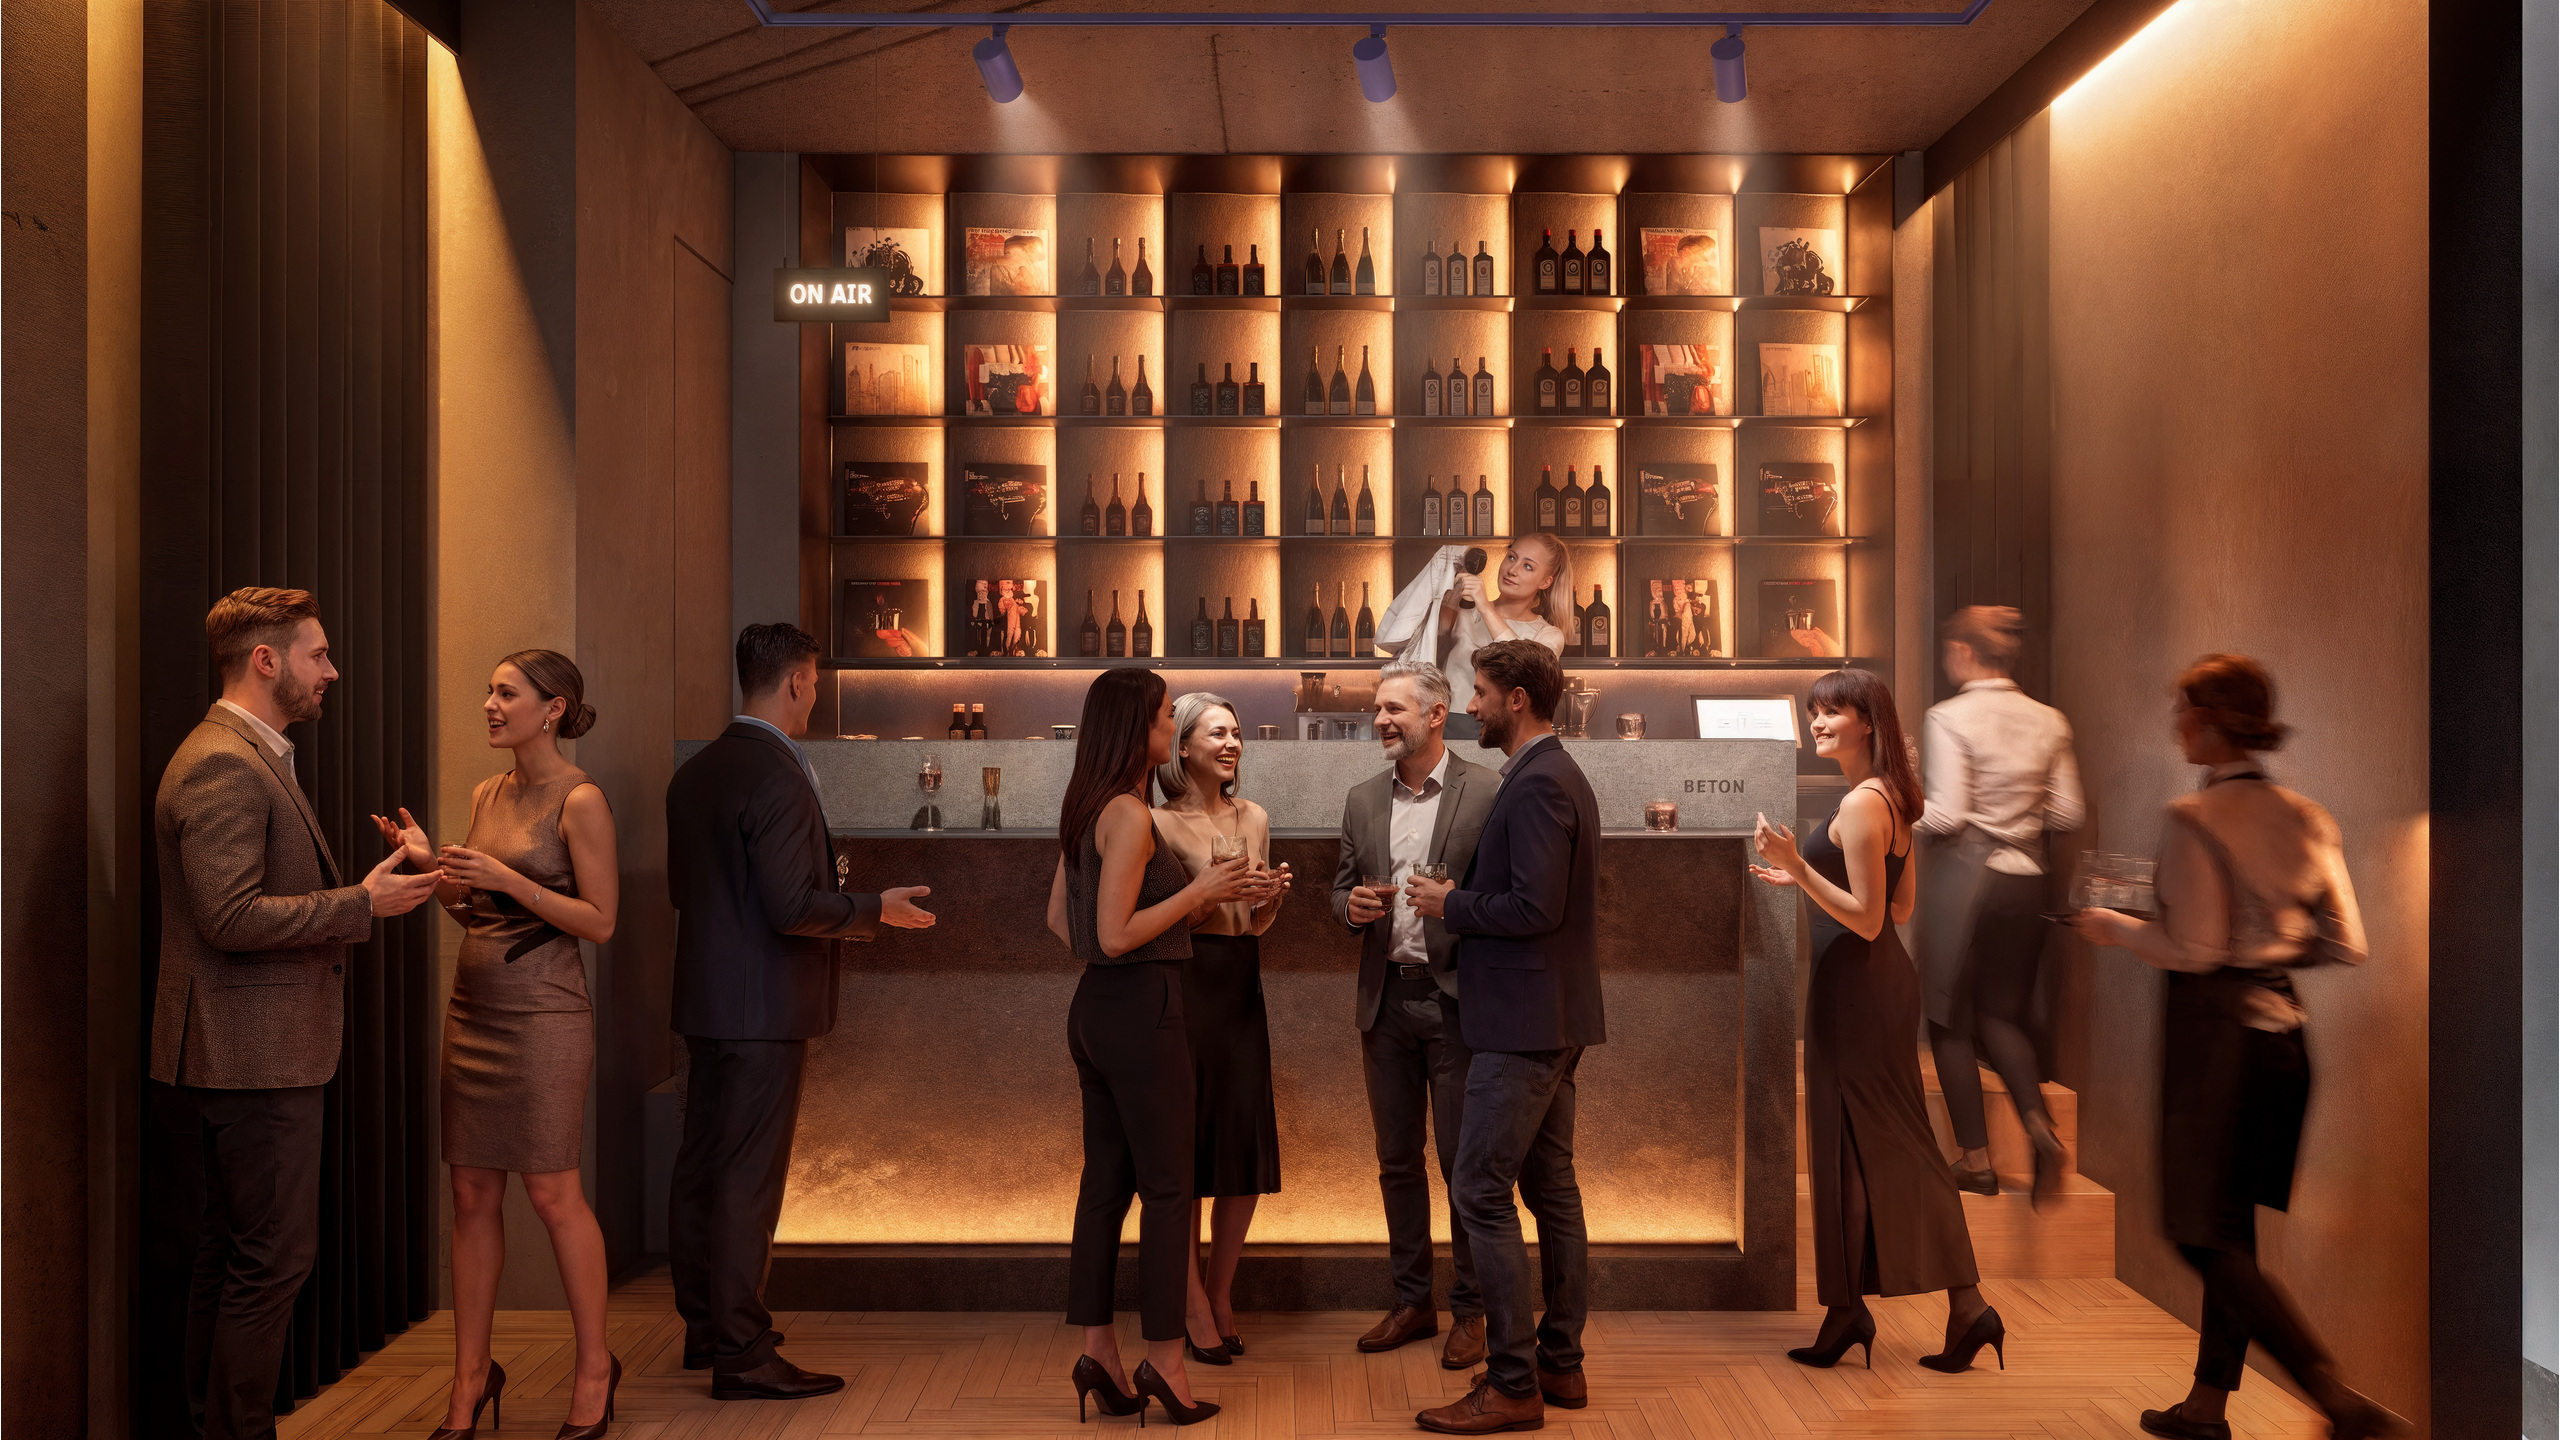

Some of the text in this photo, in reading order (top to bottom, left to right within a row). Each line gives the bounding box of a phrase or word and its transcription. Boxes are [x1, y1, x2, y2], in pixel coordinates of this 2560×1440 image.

[790, 283, 872, 304] ON AIR
[1684, 779, 1744, 793] BETON
